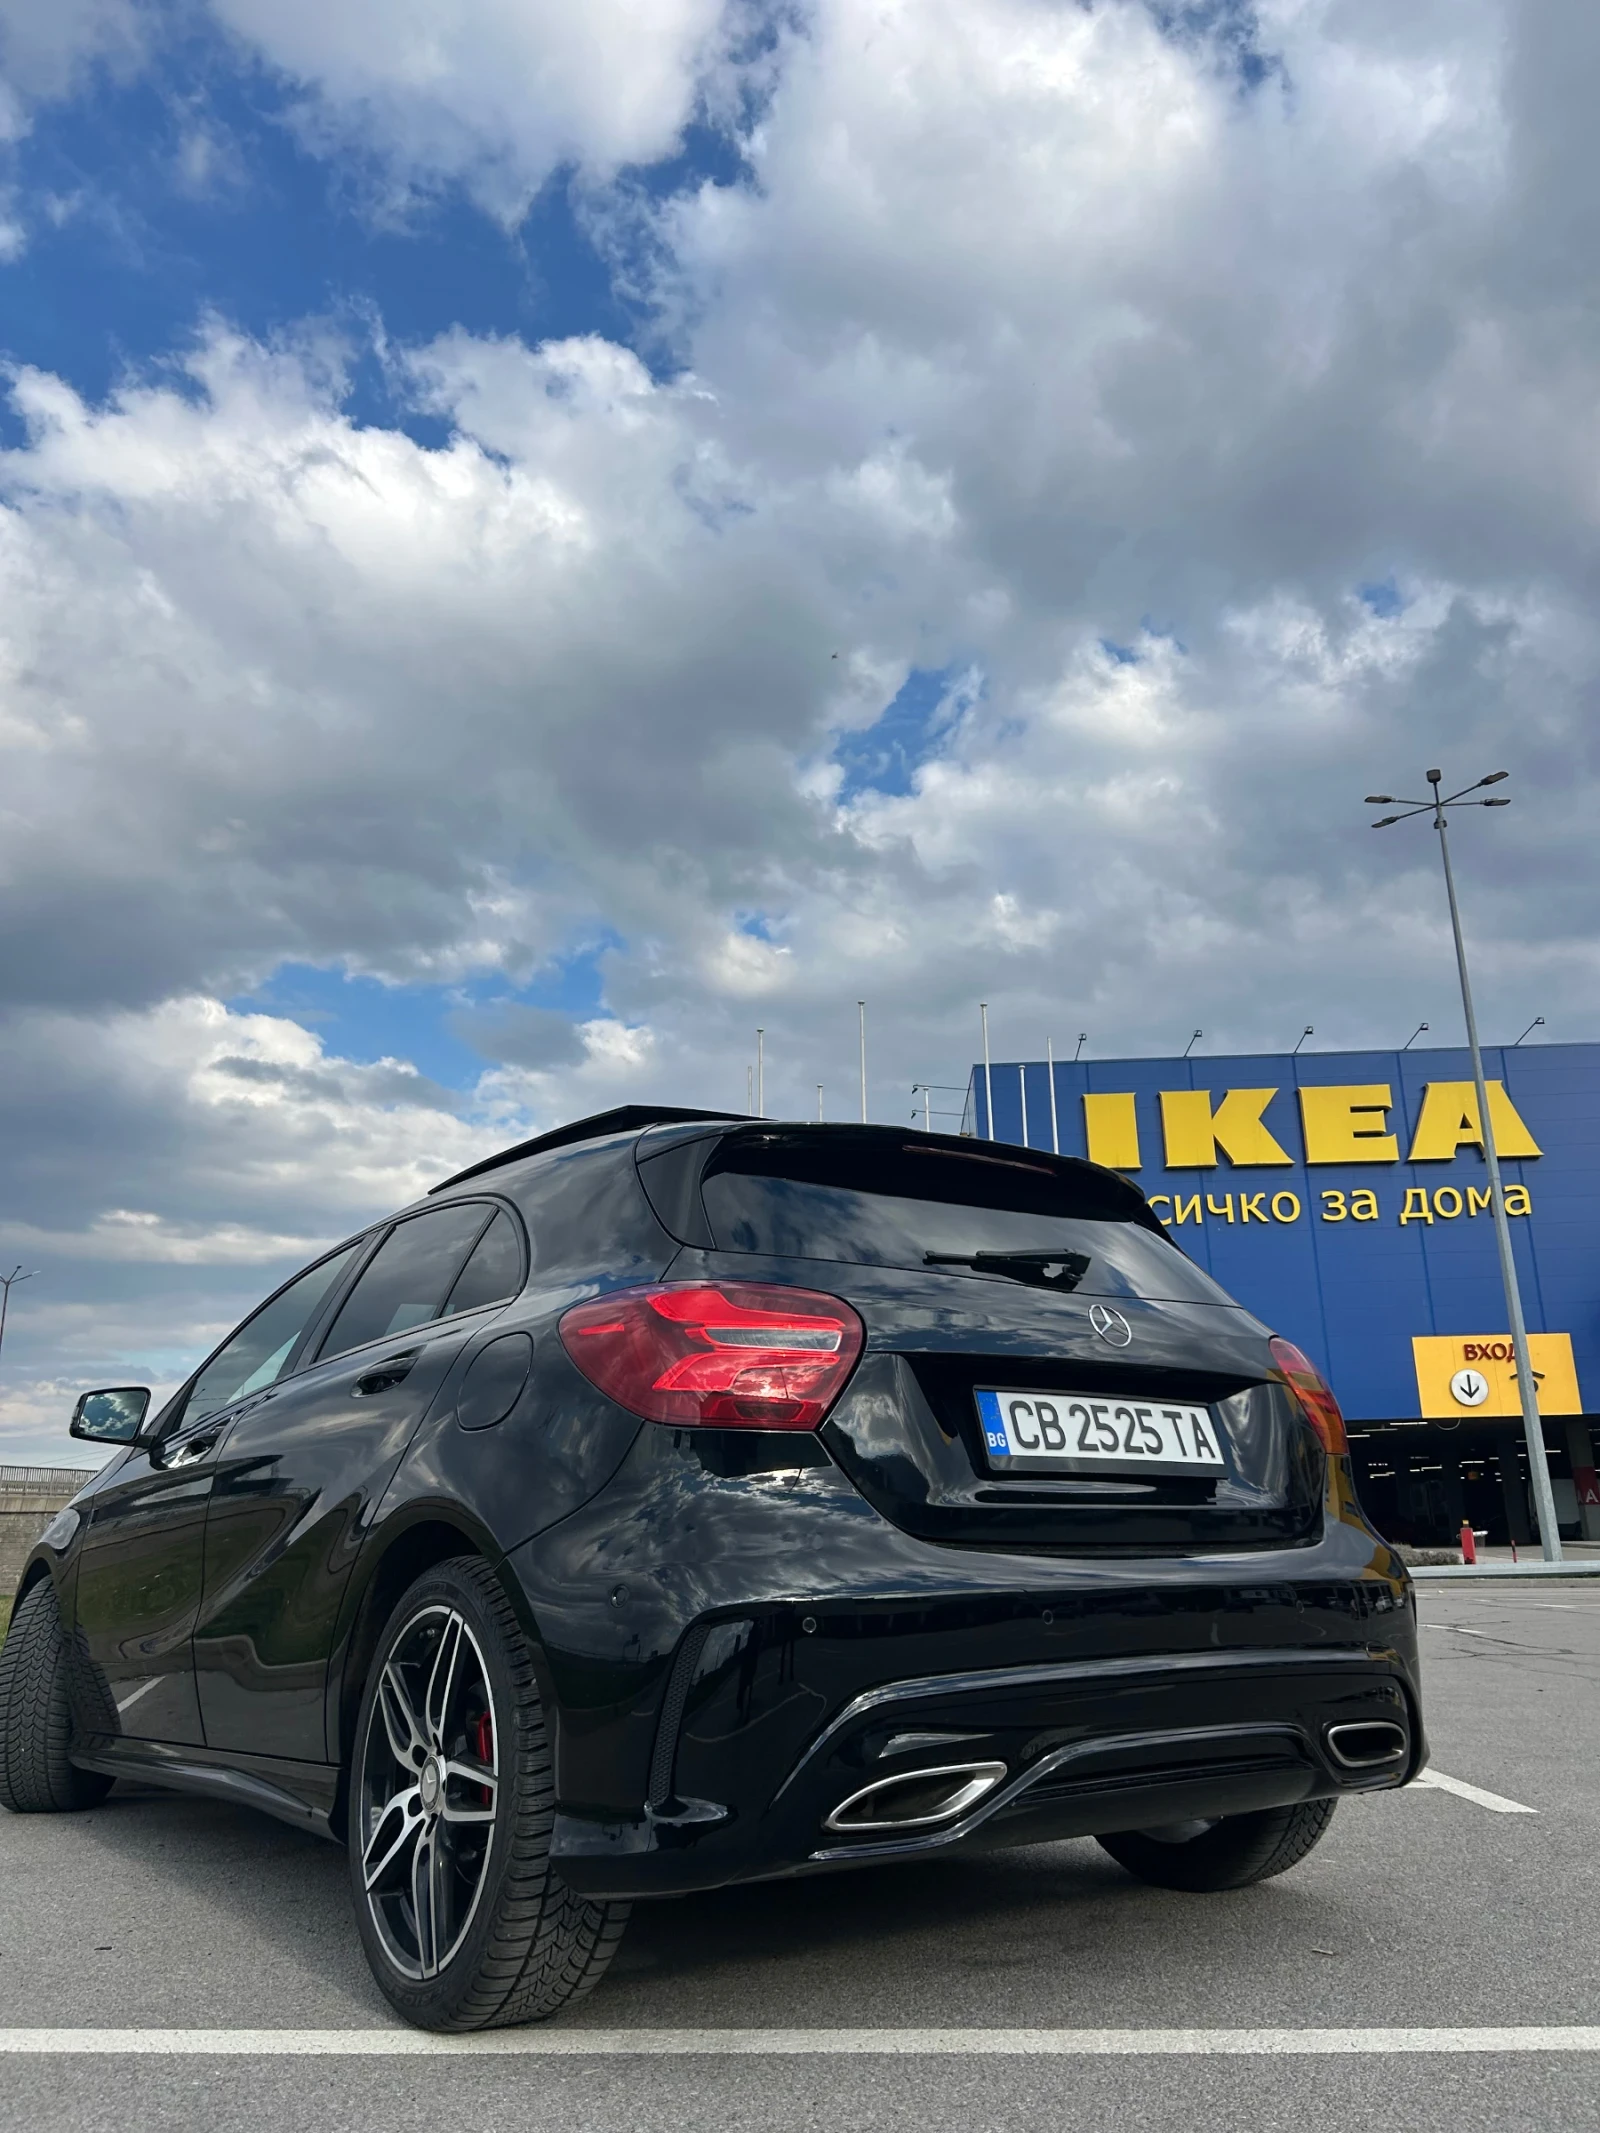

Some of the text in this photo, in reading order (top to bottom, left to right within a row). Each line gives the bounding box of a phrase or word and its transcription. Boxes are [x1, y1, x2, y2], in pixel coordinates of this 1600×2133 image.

[1082, 1080, 1545, 1170] IKEA
[1147, 1183, 1533, 1226] сичко за дома
[987, 1432, 1007, 1448] BG
[1009, 1400, 1216, 1459] CB 2525 TA
